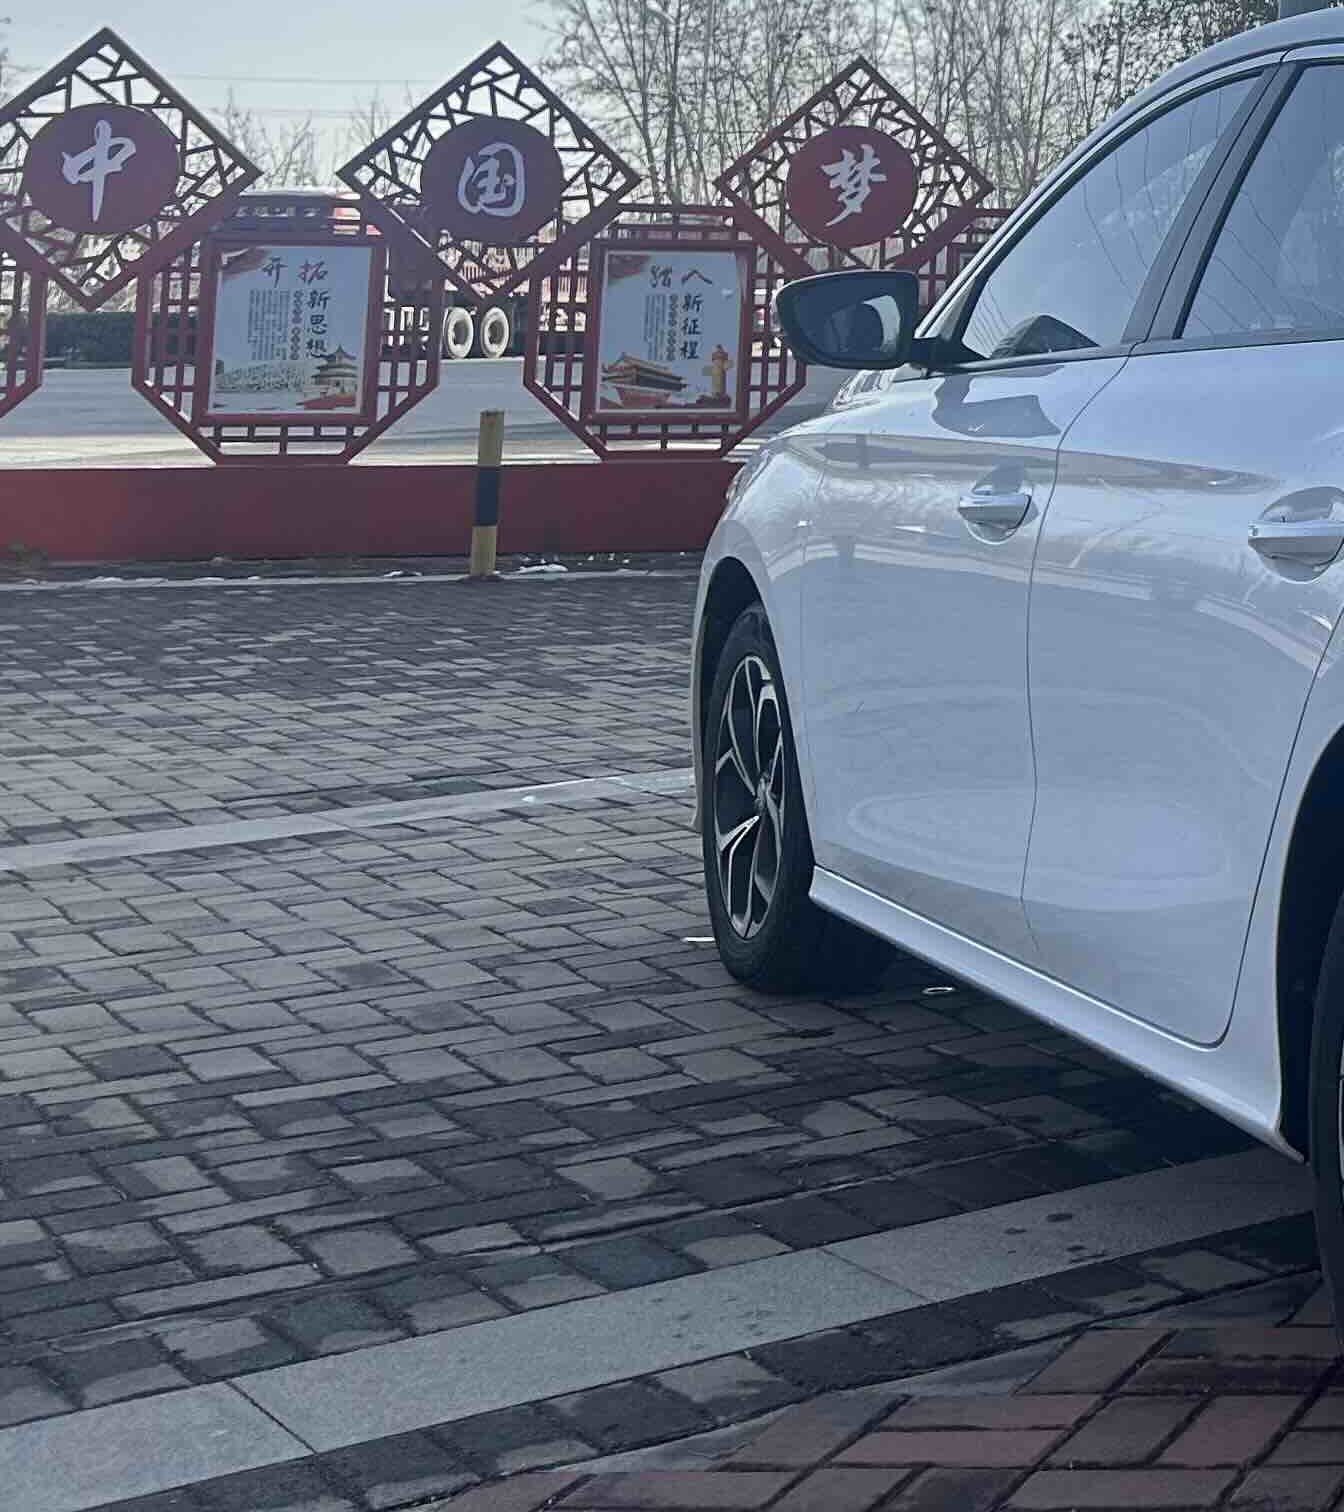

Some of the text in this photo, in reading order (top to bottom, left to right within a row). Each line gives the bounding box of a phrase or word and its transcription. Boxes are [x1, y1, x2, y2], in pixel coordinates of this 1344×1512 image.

[62, 120, 888, 227] 中 国 梦
[305, 289, 330, 359] 新思想
[680, 293, 703, 360] 新征程
